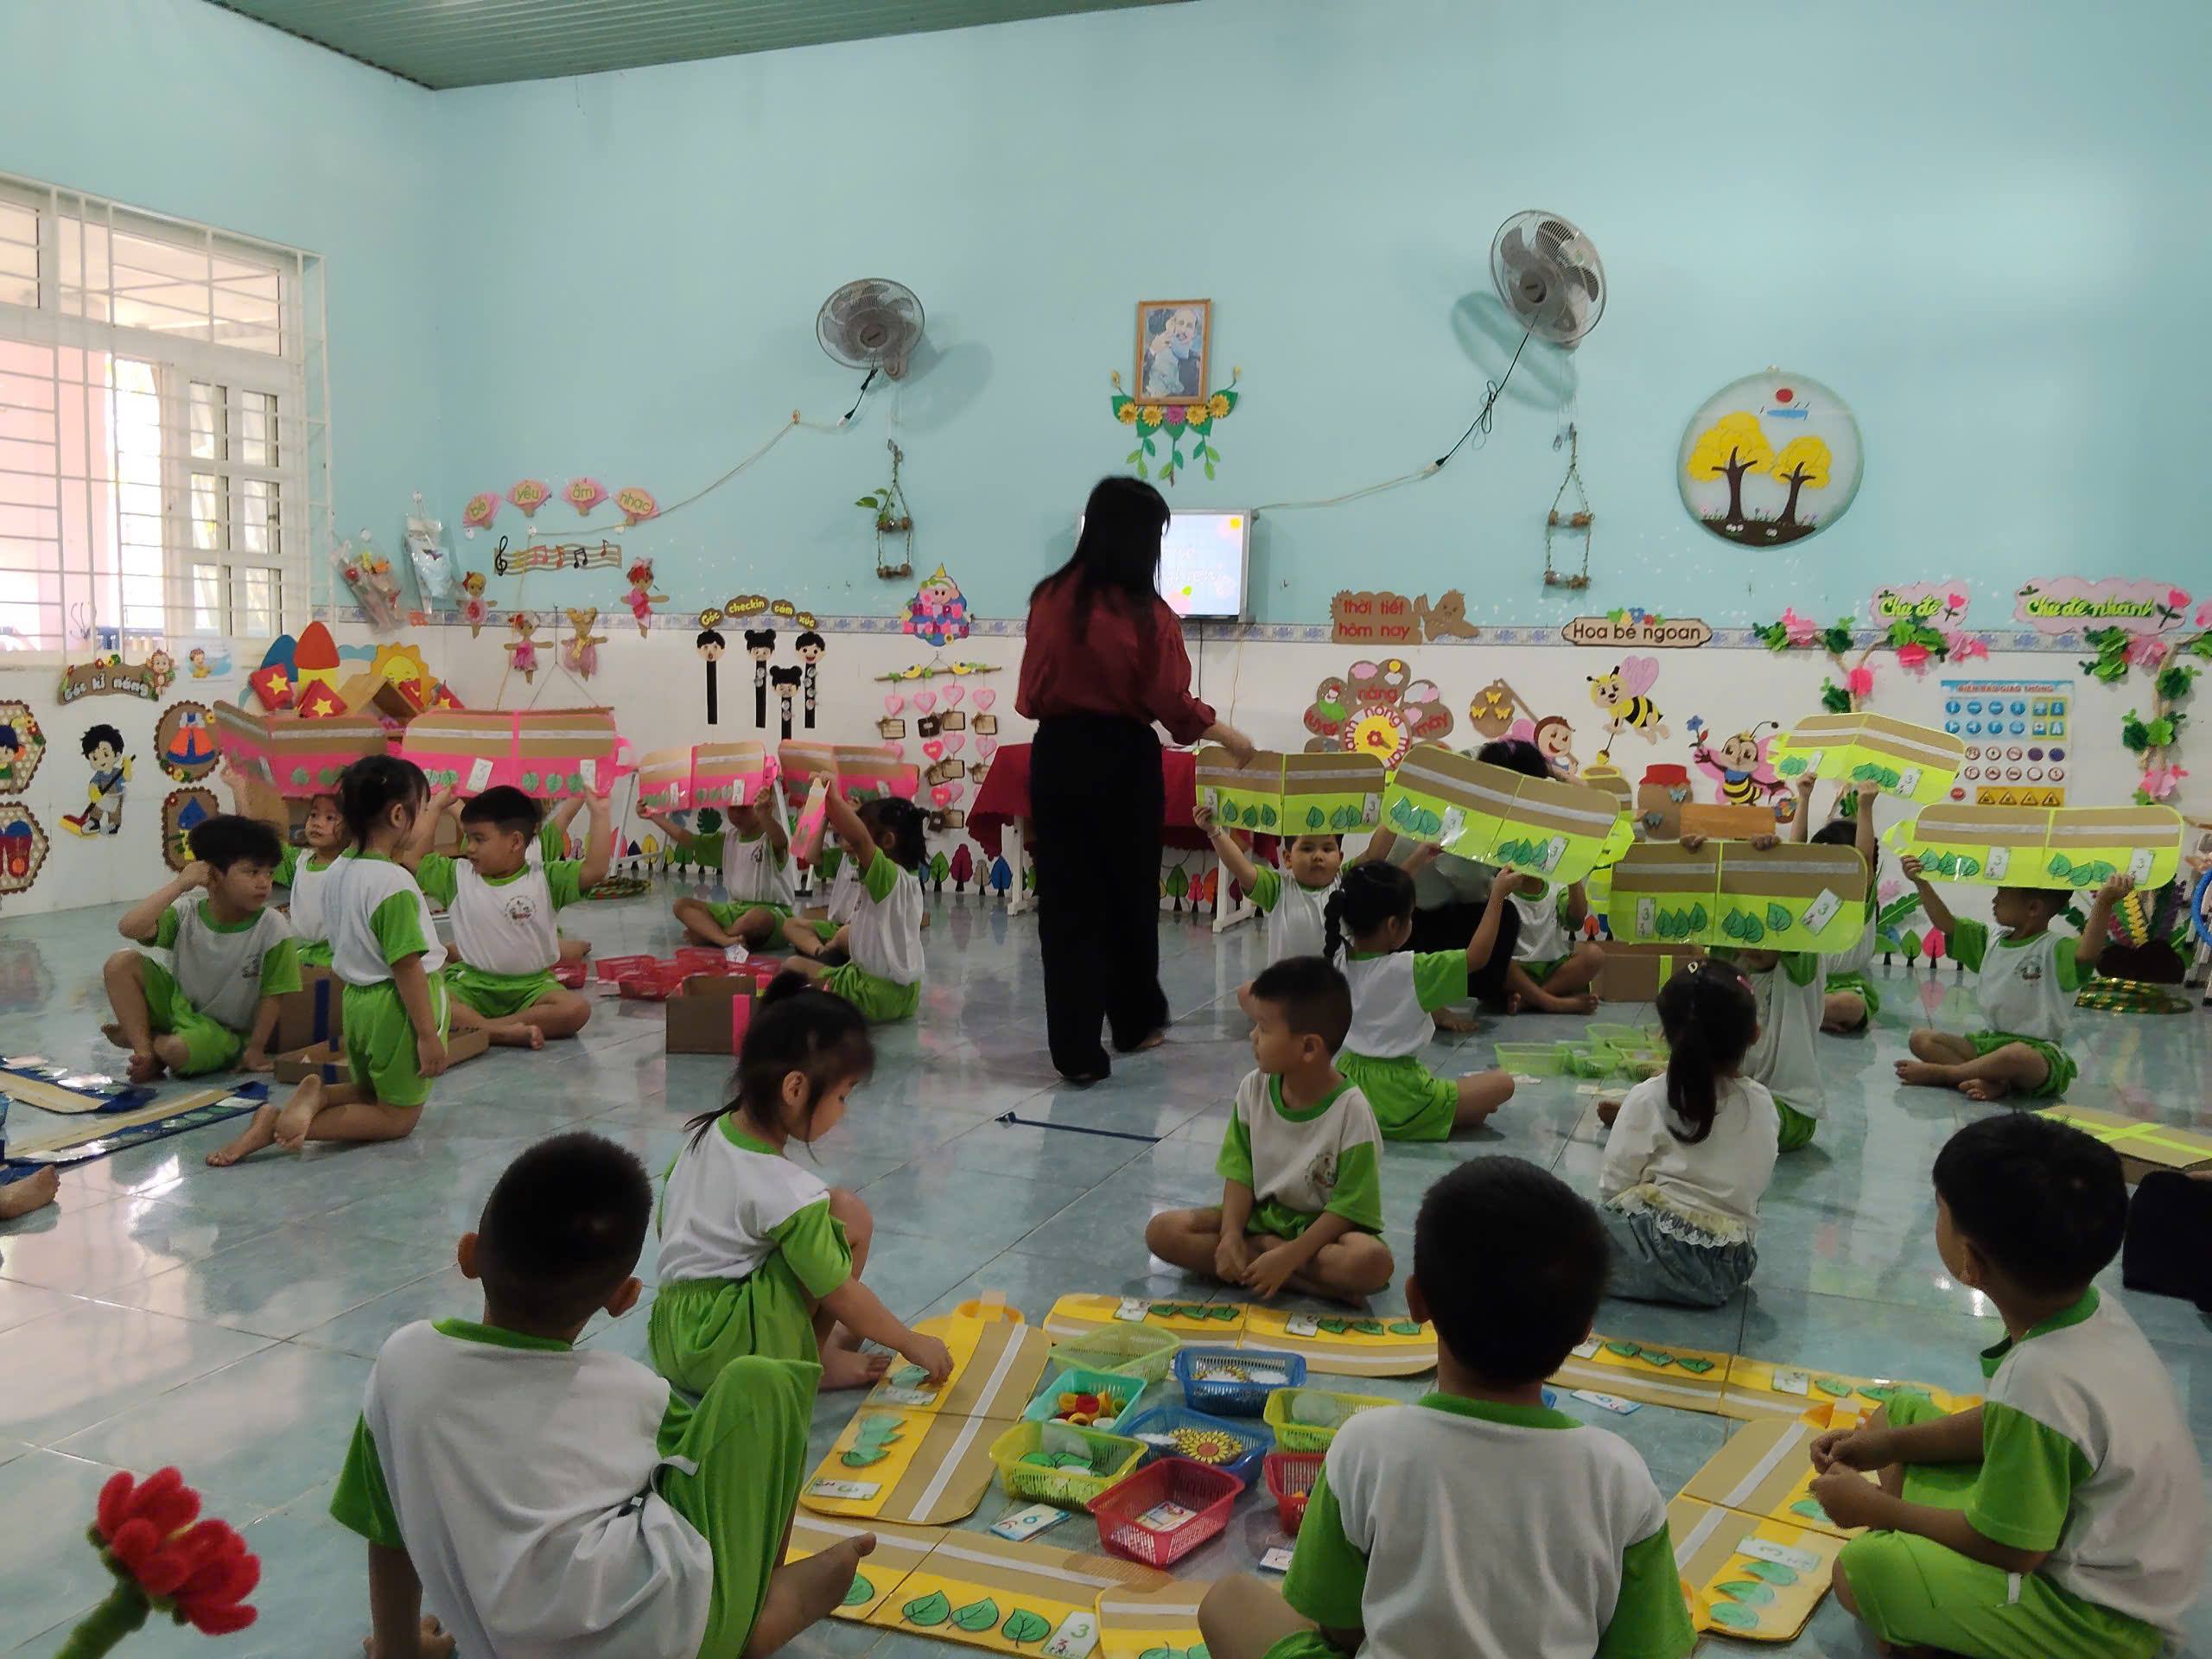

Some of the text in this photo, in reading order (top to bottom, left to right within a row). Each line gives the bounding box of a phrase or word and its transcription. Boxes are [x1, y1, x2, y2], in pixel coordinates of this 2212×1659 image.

[517, 486, 540, 501] yêu
[572, 484, 593, 499] âm
[728, 599, 766, 613] checkin
[1338, 622, 1410, 640] hôm nay
[1573, 623, 1700, 644] Hoa bé ngoan
[1071, 1624, 1090, 1639] 3
